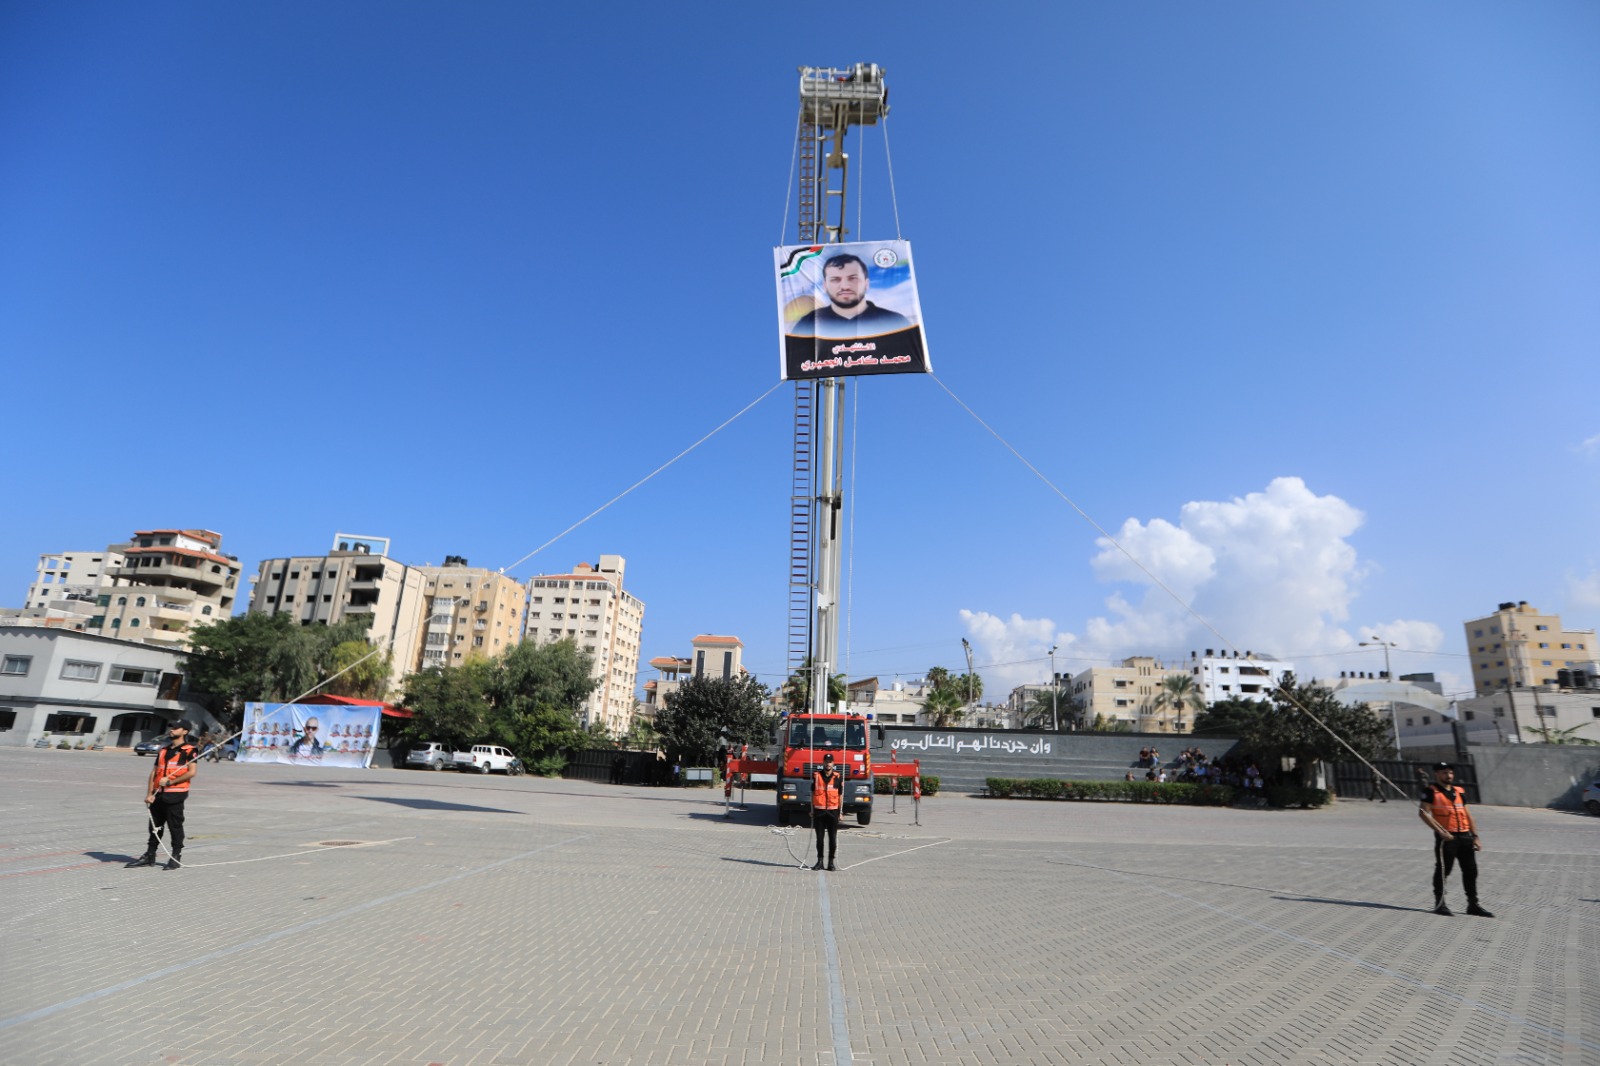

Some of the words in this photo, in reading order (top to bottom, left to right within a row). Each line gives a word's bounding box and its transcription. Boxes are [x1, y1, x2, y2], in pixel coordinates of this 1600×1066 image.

[844, 355, 879, 368] كامل
[880, 355, 911, 364] محمد
[890, 734, 955, 751] الغالبون
[956, 735, 988, 753] لهم
